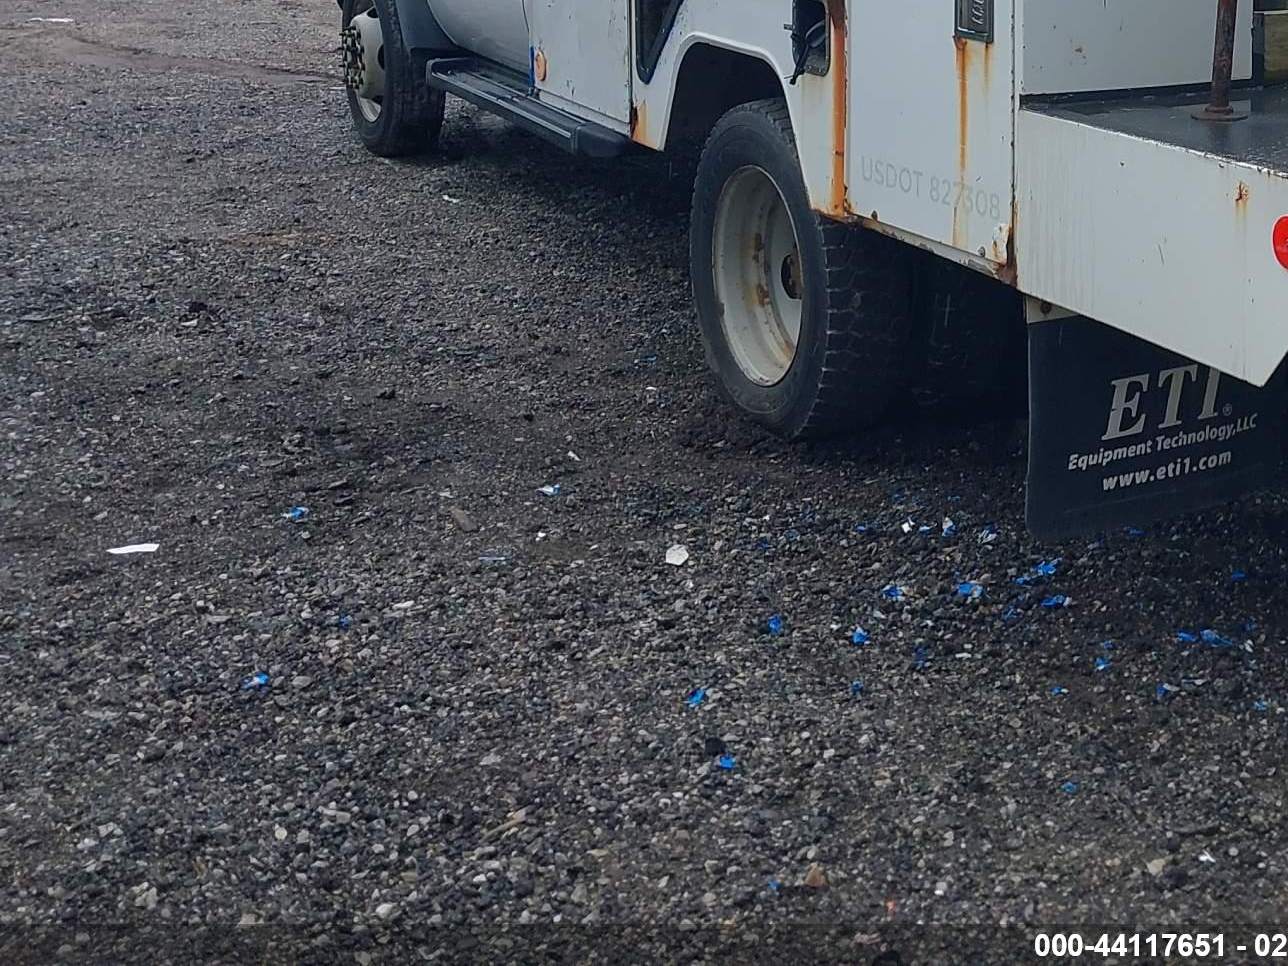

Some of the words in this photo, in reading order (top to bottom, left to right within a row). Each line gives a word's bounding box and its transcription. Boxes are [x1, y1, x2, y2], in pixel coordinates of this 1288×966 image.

[861, 154, 924, 197] USDOT
[1067, 439, 1153, 471] Equipment
[1102, 450, 1232, 491] www.eti1.com
